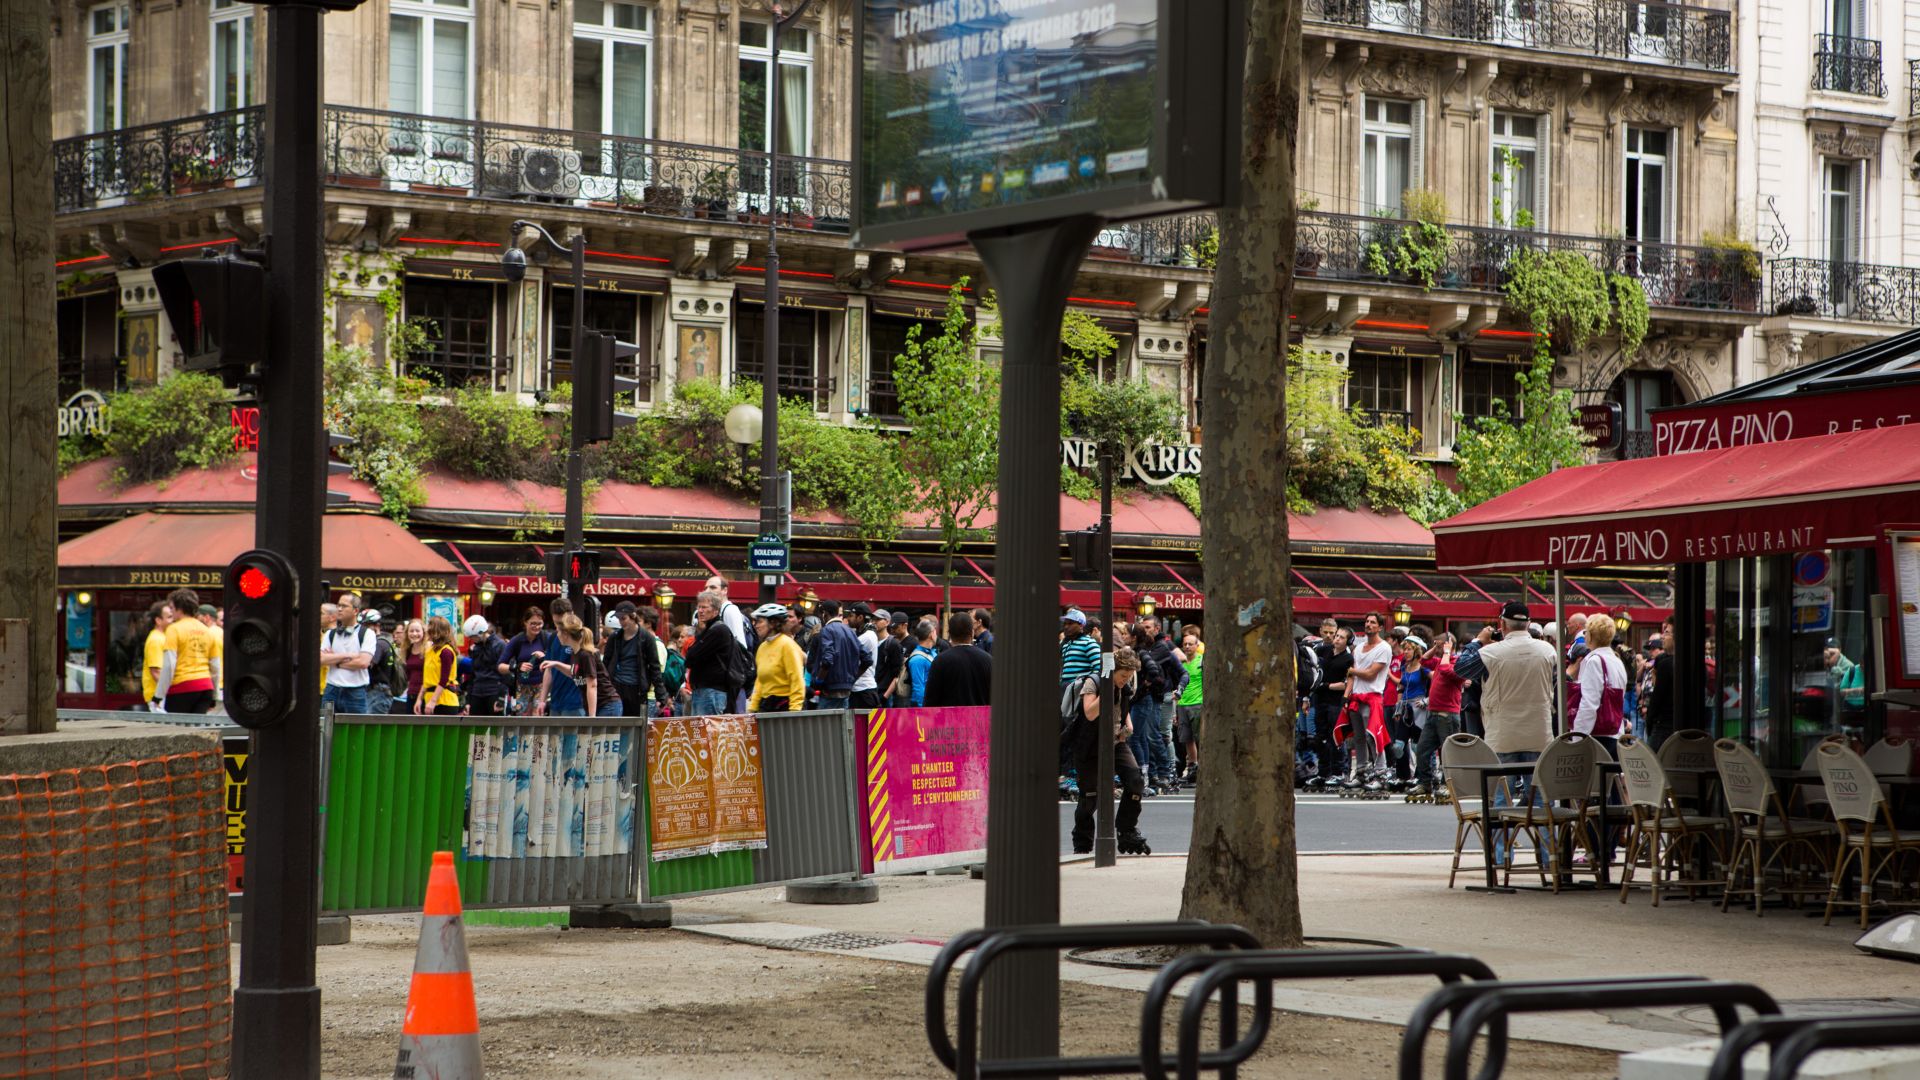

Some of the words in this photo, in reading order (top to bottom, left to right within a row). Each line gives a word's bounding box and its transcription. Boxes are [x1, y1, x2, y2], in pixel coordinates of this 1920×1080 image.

[894, 11, 908, 38] LE
[910, 0, 957, 35] PALAIS
[959, 0, 985, 23] DES
[916, 38, 960, 69] PARTIR
[962, 33, 979, 60] DU
[982, 30, 998, 56] 26
[1001, 13, 1080, 51] SEPTEMBRE
[1081, 4, 1116, 33] 2013
[452, 268, 473, 280] TK
[598, 280, 618, 291] TK
[785, 295, 803, 307] TK
[915, 307, 933, 318] TK
[1391, 345, 1406, 356] TK
[1656, 418, 1723, 457] PIZZA
[1730, 410, 1793, 448] PINO
[672, 522, 736, 533] RESTAURANT
[1548, 533, 1607, 565] PIZZA
[1615, 529, 1669, 561] PINO
[1685, 526, 1815, 558] RESTAURANT
[756, 559, 781, 567] VOLTAIRE
[129, 572, 191, 584] FRUITS
[198, 572, 222, 584] DE
[342, 576, 446, 589] COQUILLAGES
[500, 584, 516, 593] Les
[1165, 594, 1202, 609] Relais
[912, 764, 920, 775] UN
[922, 761, 954, 774] CHANTIER
[912, 776, 957, 790] RESPECTUEUX
[913, 794, 922, 805] DE
[924, 789, 981, 805] L'ENVIRONNEMENT
